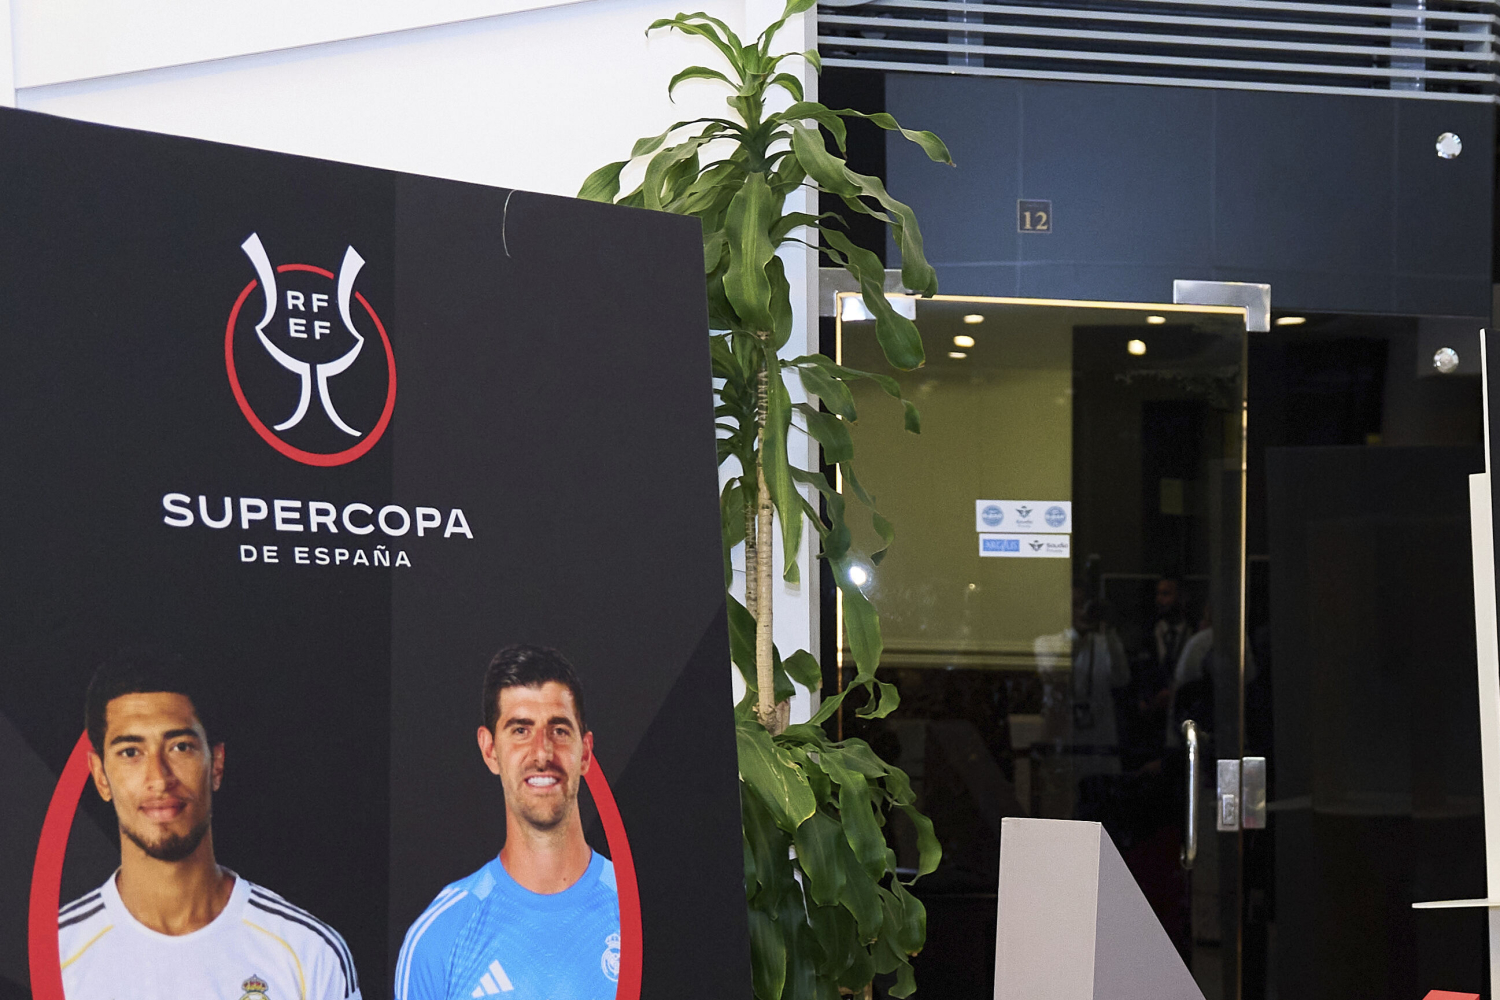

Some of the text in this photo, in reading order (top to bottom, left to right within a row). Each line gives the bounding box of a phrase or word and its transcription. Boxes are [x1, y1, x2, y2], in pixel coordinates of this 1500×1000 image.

[1023, 211, 1048, 230] 12
[162, 493, 474, 539] SUPERCOPA
[240, 545, 411, 567] DE ESPAÑA
